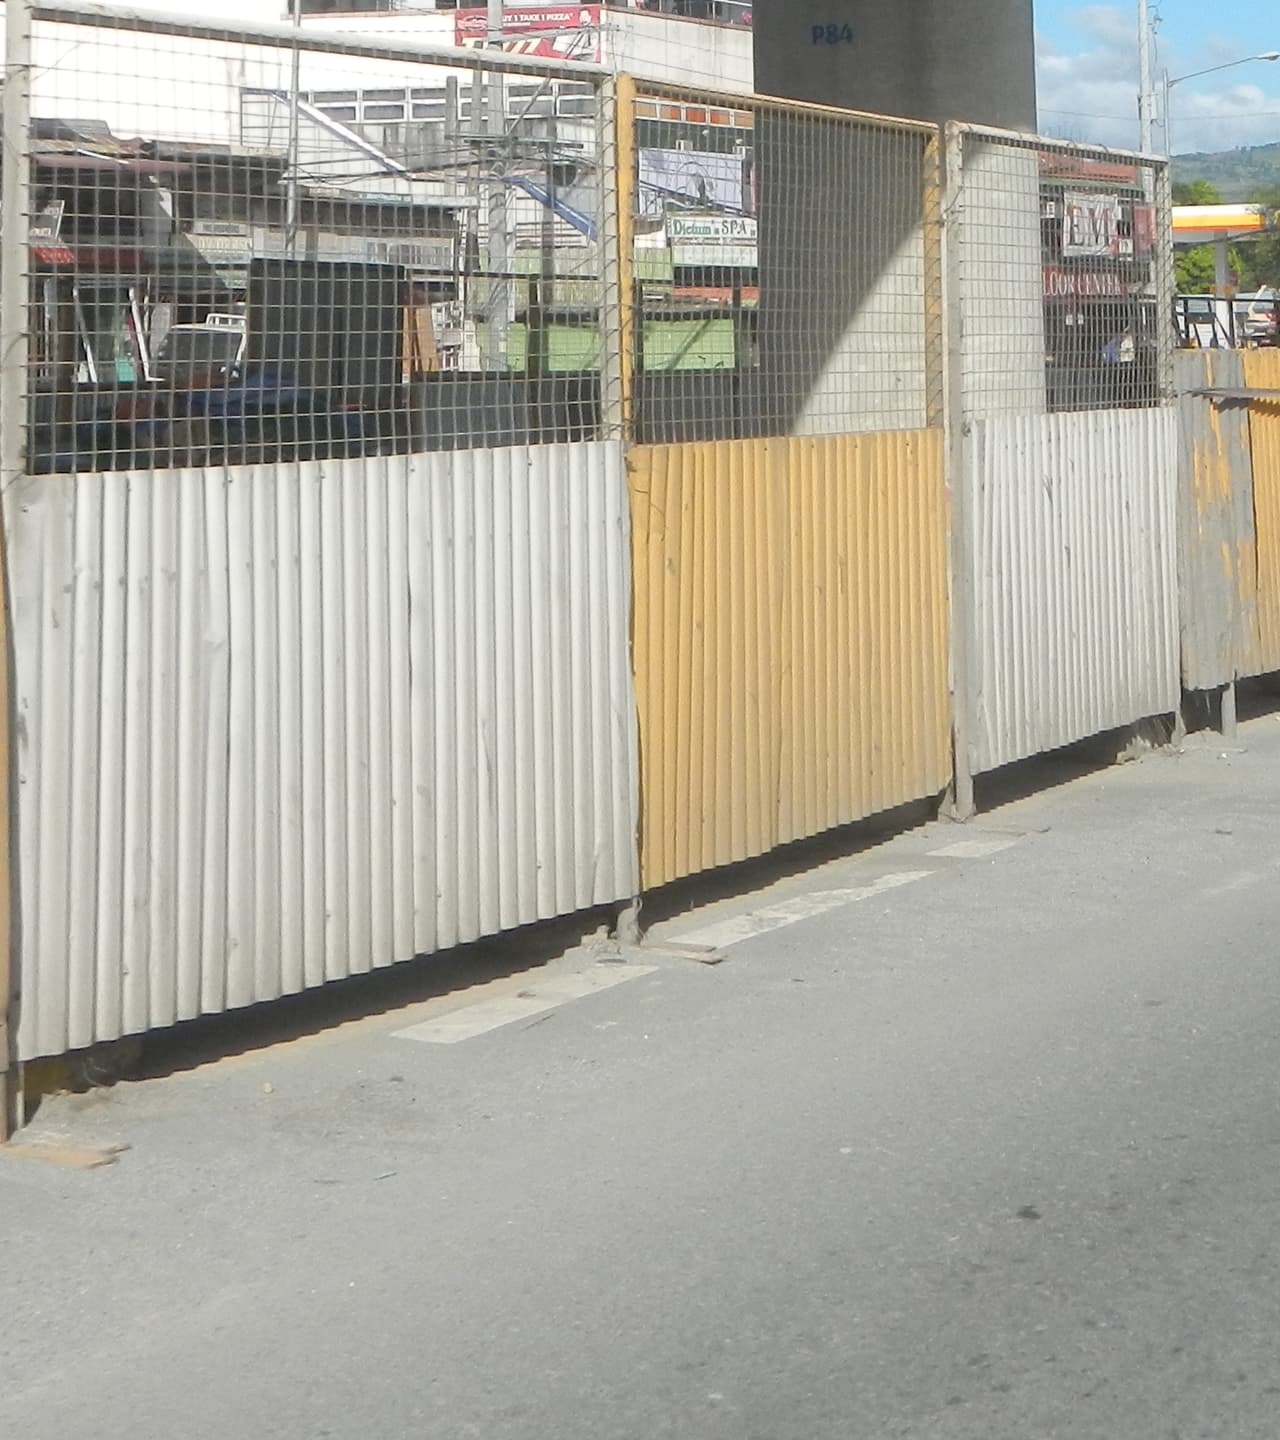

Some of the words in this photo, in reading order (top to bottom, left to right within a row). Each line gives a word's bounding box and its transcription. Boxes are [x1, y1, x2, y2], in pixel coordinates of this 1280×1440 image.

[812, 23, 853, 45] P84
[722, 220, 747, 235] SPA
[1043, 271, 1075, 296] LOOR
